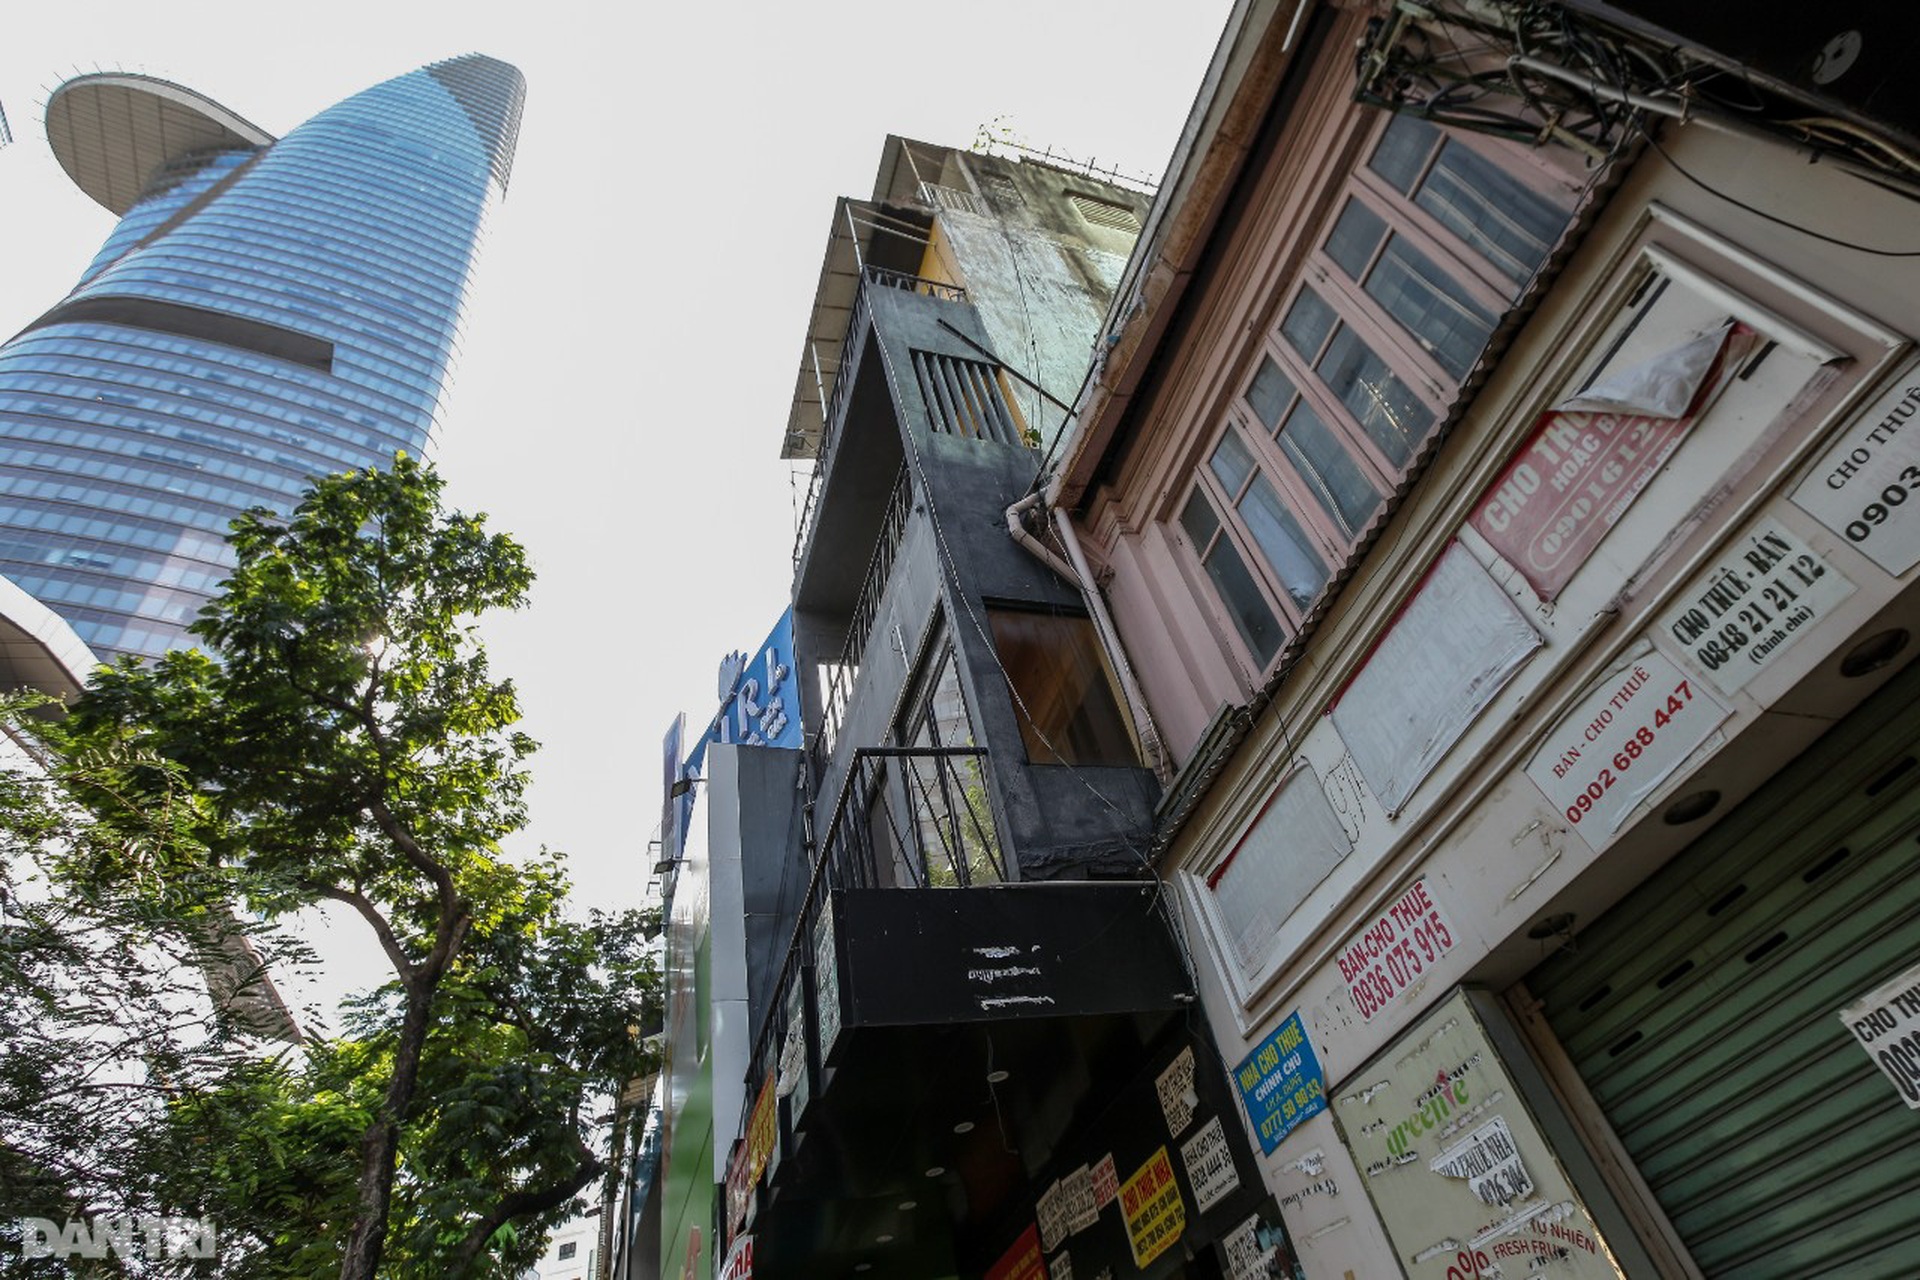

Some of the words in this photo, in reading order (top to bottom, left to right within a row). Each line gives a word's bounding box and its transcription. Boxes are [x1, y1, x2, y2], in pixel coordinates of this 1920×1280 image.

[1483, 463, 1541, 533] CHO
[1541, 418, 1663, 555] 0901612
[1827, 447, 1870, 490] CHO
[1671, 606, 1712, 647] CHO
[1697, 566, 1752, 620] THUÊ
[1743, 531, 1792, 578] BÁN
[1696, 620, 1750, 672] 0848
[1738, 601, 1774, 635] 21
[1764, 578, 1800, 614] 21
[1789, 553, 1826, 588] 12
[1748, 626, 1789, 666] (Chính
[1785, 604, 1816, 640] chủ)
[1551, 746, 1583, 780] BÁN
[1583, 708, 1615, 743] CHO
[1609, 665, 1652, 712] THUÊ
[1565, 769, 1617, 825] 0902
[1612, 725, 1656, 773] 688
[1654, 679, 1695, 731] 447
[1351, 964, 1395, 1020] 0936
[1385, 937, 1423, 989] 075
[1413, 910, 1453, 963] 915
[1853, 1006, 1897, 1043] CHO
[1254, 1067, 1285, 1103] CHÍNH
[1257, 1041, 1281, 1078] CHO
[1492, 1239, 1530, 1260] FRESH
[1550, 1222, 1597, 1256] NHIÊN
